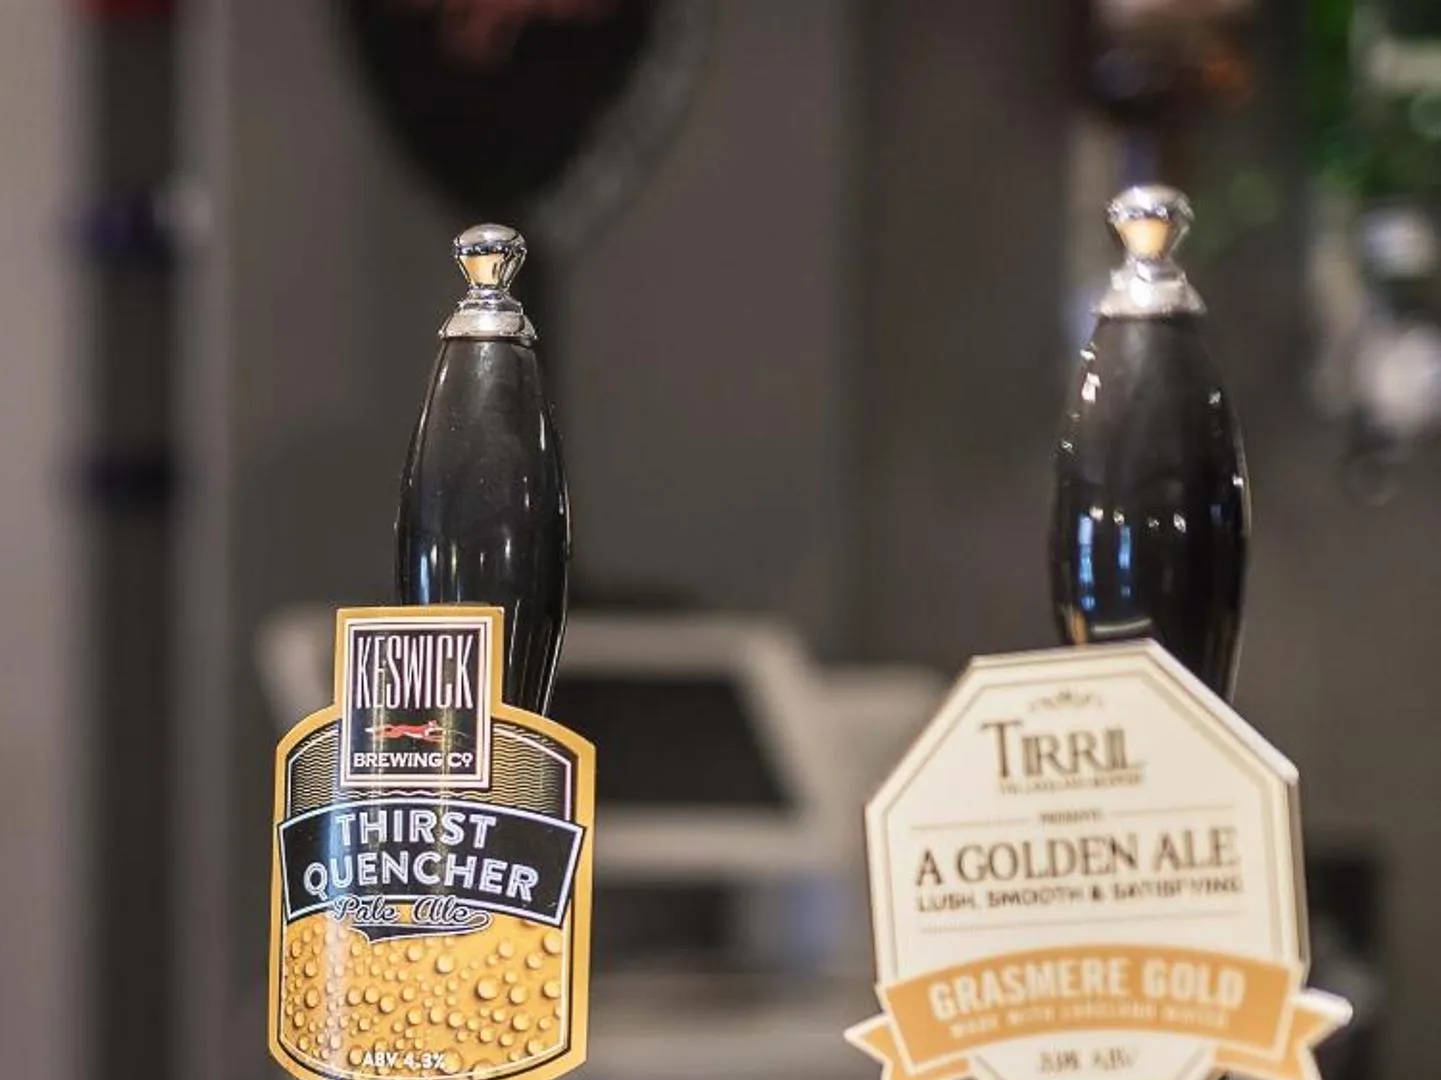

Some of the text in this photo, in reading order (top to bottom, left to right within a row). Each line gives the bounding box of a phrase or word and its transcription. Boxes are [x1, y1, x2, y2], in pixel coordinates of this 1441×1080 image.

[356, 634, 473, 710] KESWICK
[353, 751, 442, 768] BREWING
[335, 809, 497, 850] THIRST
[303, 850, 540, 902] QUENCHER
[915, 826, 1241, 886] A GOLDEN ALE
[332, 894, 474, 925] Pale Ale
[927, 956, 1132, 1022] GRASMERE
[1142, 958, 1247, 1012] GOLD
[362, 1051, 398, 1068] ABV
